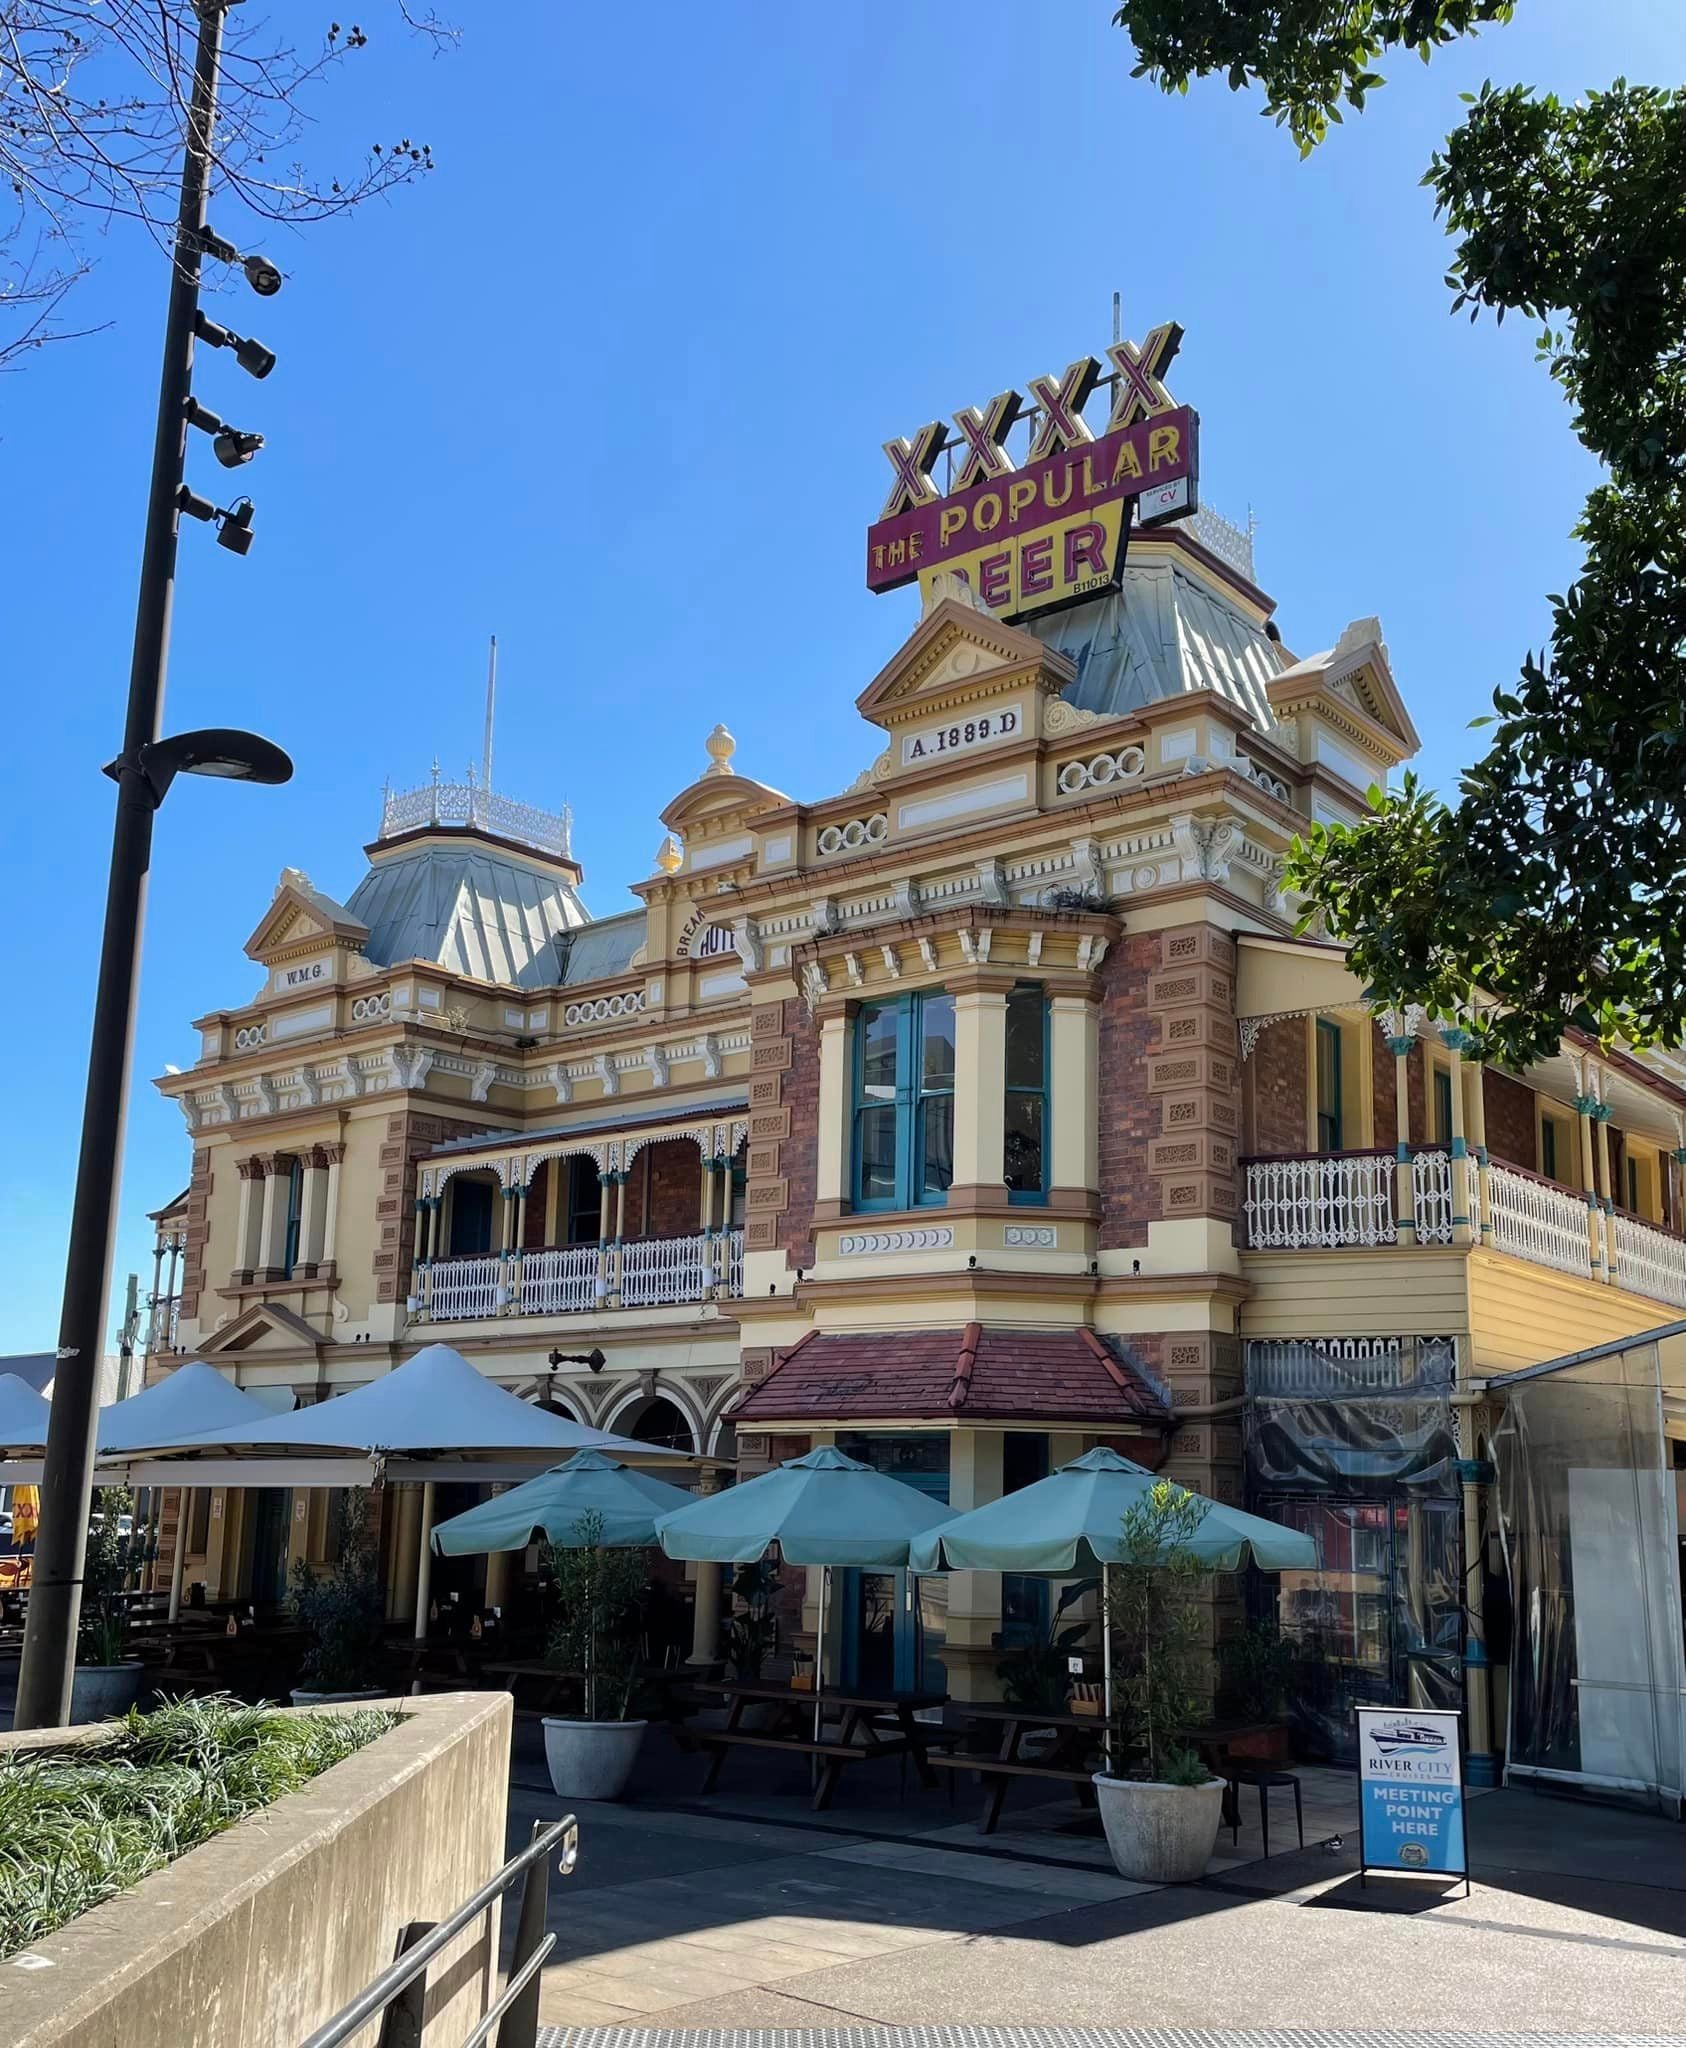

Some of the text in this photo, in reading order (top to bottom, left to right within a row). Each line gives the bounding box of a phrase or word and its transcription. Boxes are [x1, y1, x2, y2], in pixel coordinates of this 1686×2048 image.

[878, 320, 1185, 521] XXXX
[871, 425, 1182, 572] THE POPULAR
[932, 521, 1109, 608] EER
[1369, 1758, 1453, 1774] RIVER CITY
[1389, 1772, 1432, 1780] CRUISES
[1373, 1786, 1455, 1804] MEETING
[1386, 1804, 1443, 1820] POINT
[1392, 1821, 1438, 1836] HERE
